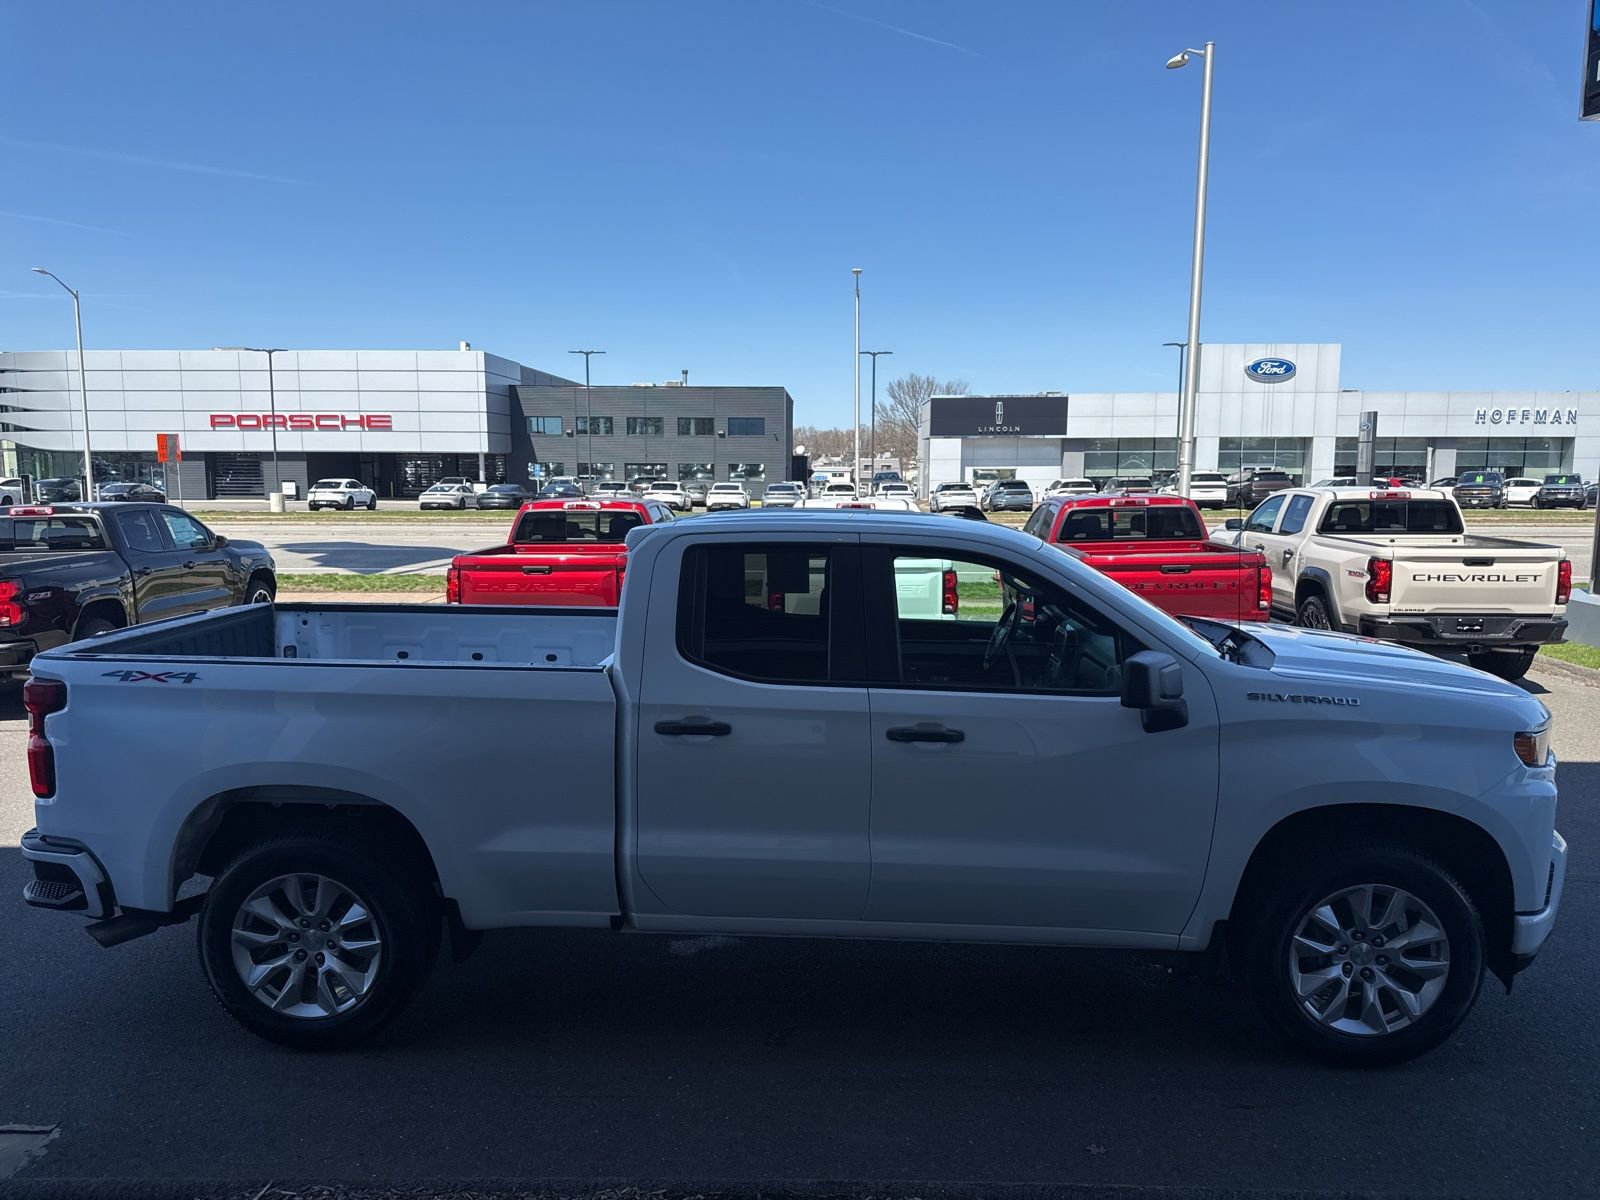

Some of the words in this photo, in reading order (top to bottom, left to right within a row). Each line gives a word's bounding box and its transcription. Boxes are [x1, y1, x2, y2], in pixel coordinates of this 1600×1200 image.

[1257, 361, 1287, 374] Ford
[209, 414, 393, 430] PORSCHE
[1475, 409, 1578, 424] HOFFMAN
[1412, 574, 1543, 582] CHEVROLET
[475, 583, 600, 591] CHEVROLET
[1125, 581, 1239, 590] HEVROLET
[1247, 692, 1361, 706] SILVERADO
